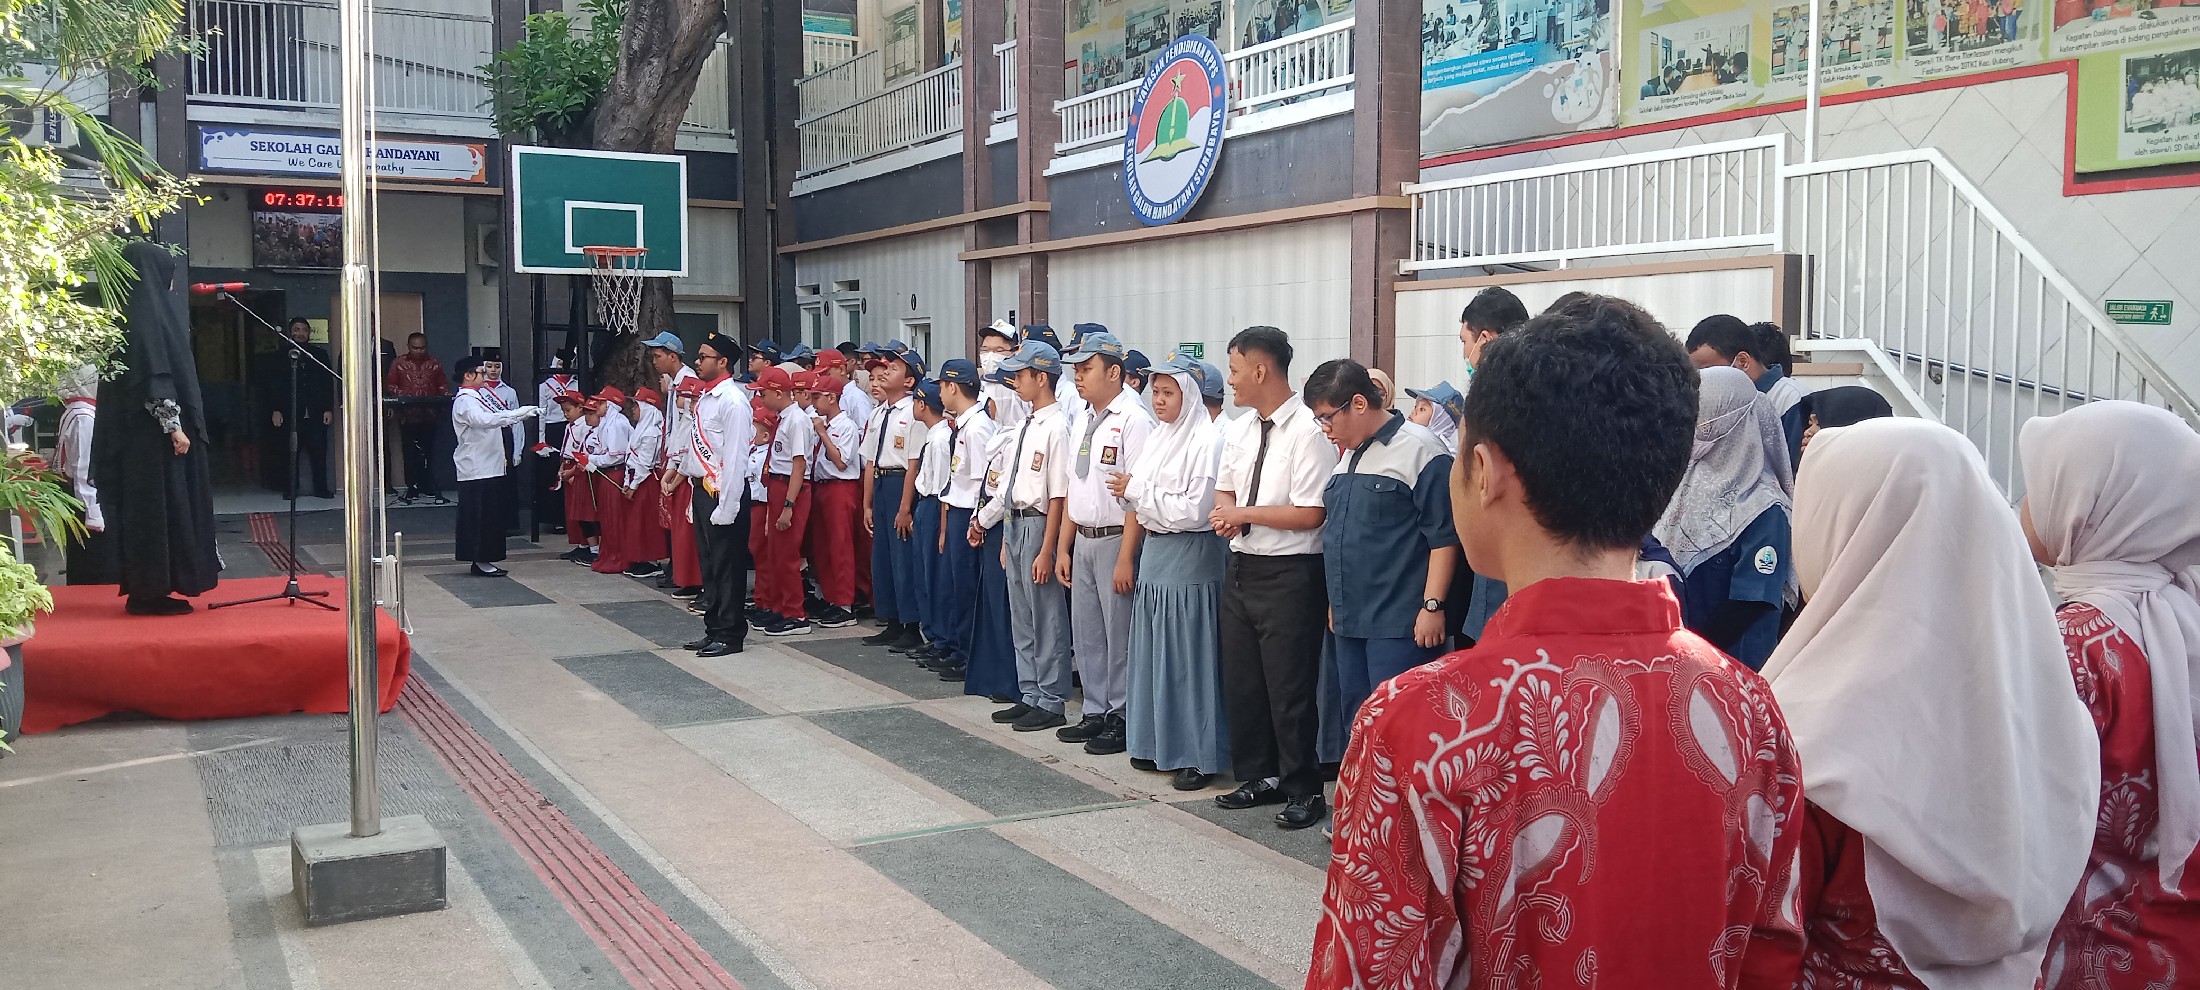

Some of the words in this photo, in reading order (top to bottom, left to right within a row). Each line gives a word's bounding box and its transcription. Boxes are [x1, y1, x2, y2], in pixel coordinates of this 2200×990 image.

[2065, 32, 2092, 42] Kegiatan
[2093, 27, 2118, 38] Cooking
[2119, 24, 2137, 34] Class
[2138, 20, 2170, 31] dilakukan
[2171, 15, 2190, 25] untuk
[2059, 41, 2099, 53] keterampilan
[2128, 33, 2150, 43] bidang
[2151, 27, 2190, 42] pengolahan
[1962, 50, 1995, 59] Montessori
[1874, 58, 1891, 68] TIMUR
[1922, 65, 1944, 75] Fashion
[1944, 64, 1959, 72] Show
[1137, 59, 1165, 104] YAYASAN
[1165, 40, 1207, 64] PENDIDIKAN
[1203, 49, 1219, 79] BPPS
[250, 140, 312, 155] SEKOLAH
[316, 144, 342, 156] GAL
[2146, 136, 2173, 146] Kegiatan
[2134, 148, 2148, 156] oleh
[2173, 143, 2183, 152] SD
[288, 157, 305, 167] We
[308, 157, 333, 169] Care
[1126, 138, 1137, 195] SEKOLAH
[1132, 190, 1151, 218] GALUH
[1151, 181, 1196, 219] HANDAYANI
[1194, 108, 1222, 185] SURABAYA
[264, 192, 344, 207] 07:37:11
